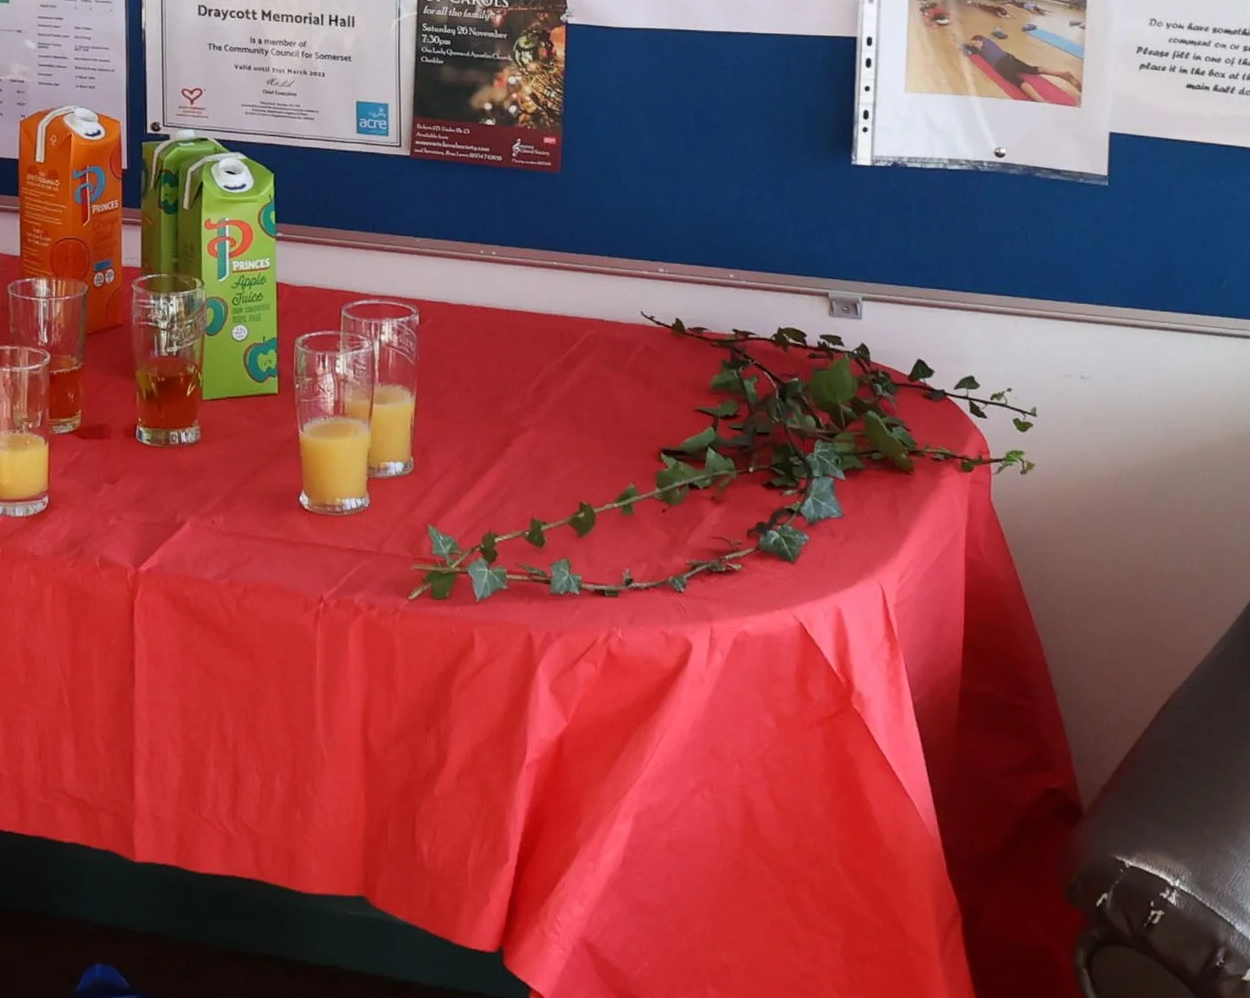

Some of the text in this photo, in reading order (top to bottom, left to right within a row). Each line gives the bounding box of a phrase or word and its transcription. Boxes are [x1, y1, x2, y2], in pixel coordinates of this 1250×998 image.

[198, 4, 355, 28] Draycott Memorial Hall
[422, 23, 508, 39] Saturday 26 November
[1149, 18, 1163, 27] Do
[1166, 22, 1184, 31] you
[1187, 23, 1209, 33] have
[264, 39, 296, 48] member
[299, 40, 306, 48] of
[1168, 37, 1212, 48] comment
[208, 43, 352, 62] The Community Council for Somerset
[1139, 63, 1239, 80] place it in the box at
[359, 118, 387, 129] acre
[92, 200, 118, 214] PRINCES
[232, 258, 270, 271] PRINCES
[230, 274, 267, 289] Apple
[231, 292, 264, 306] Juice
